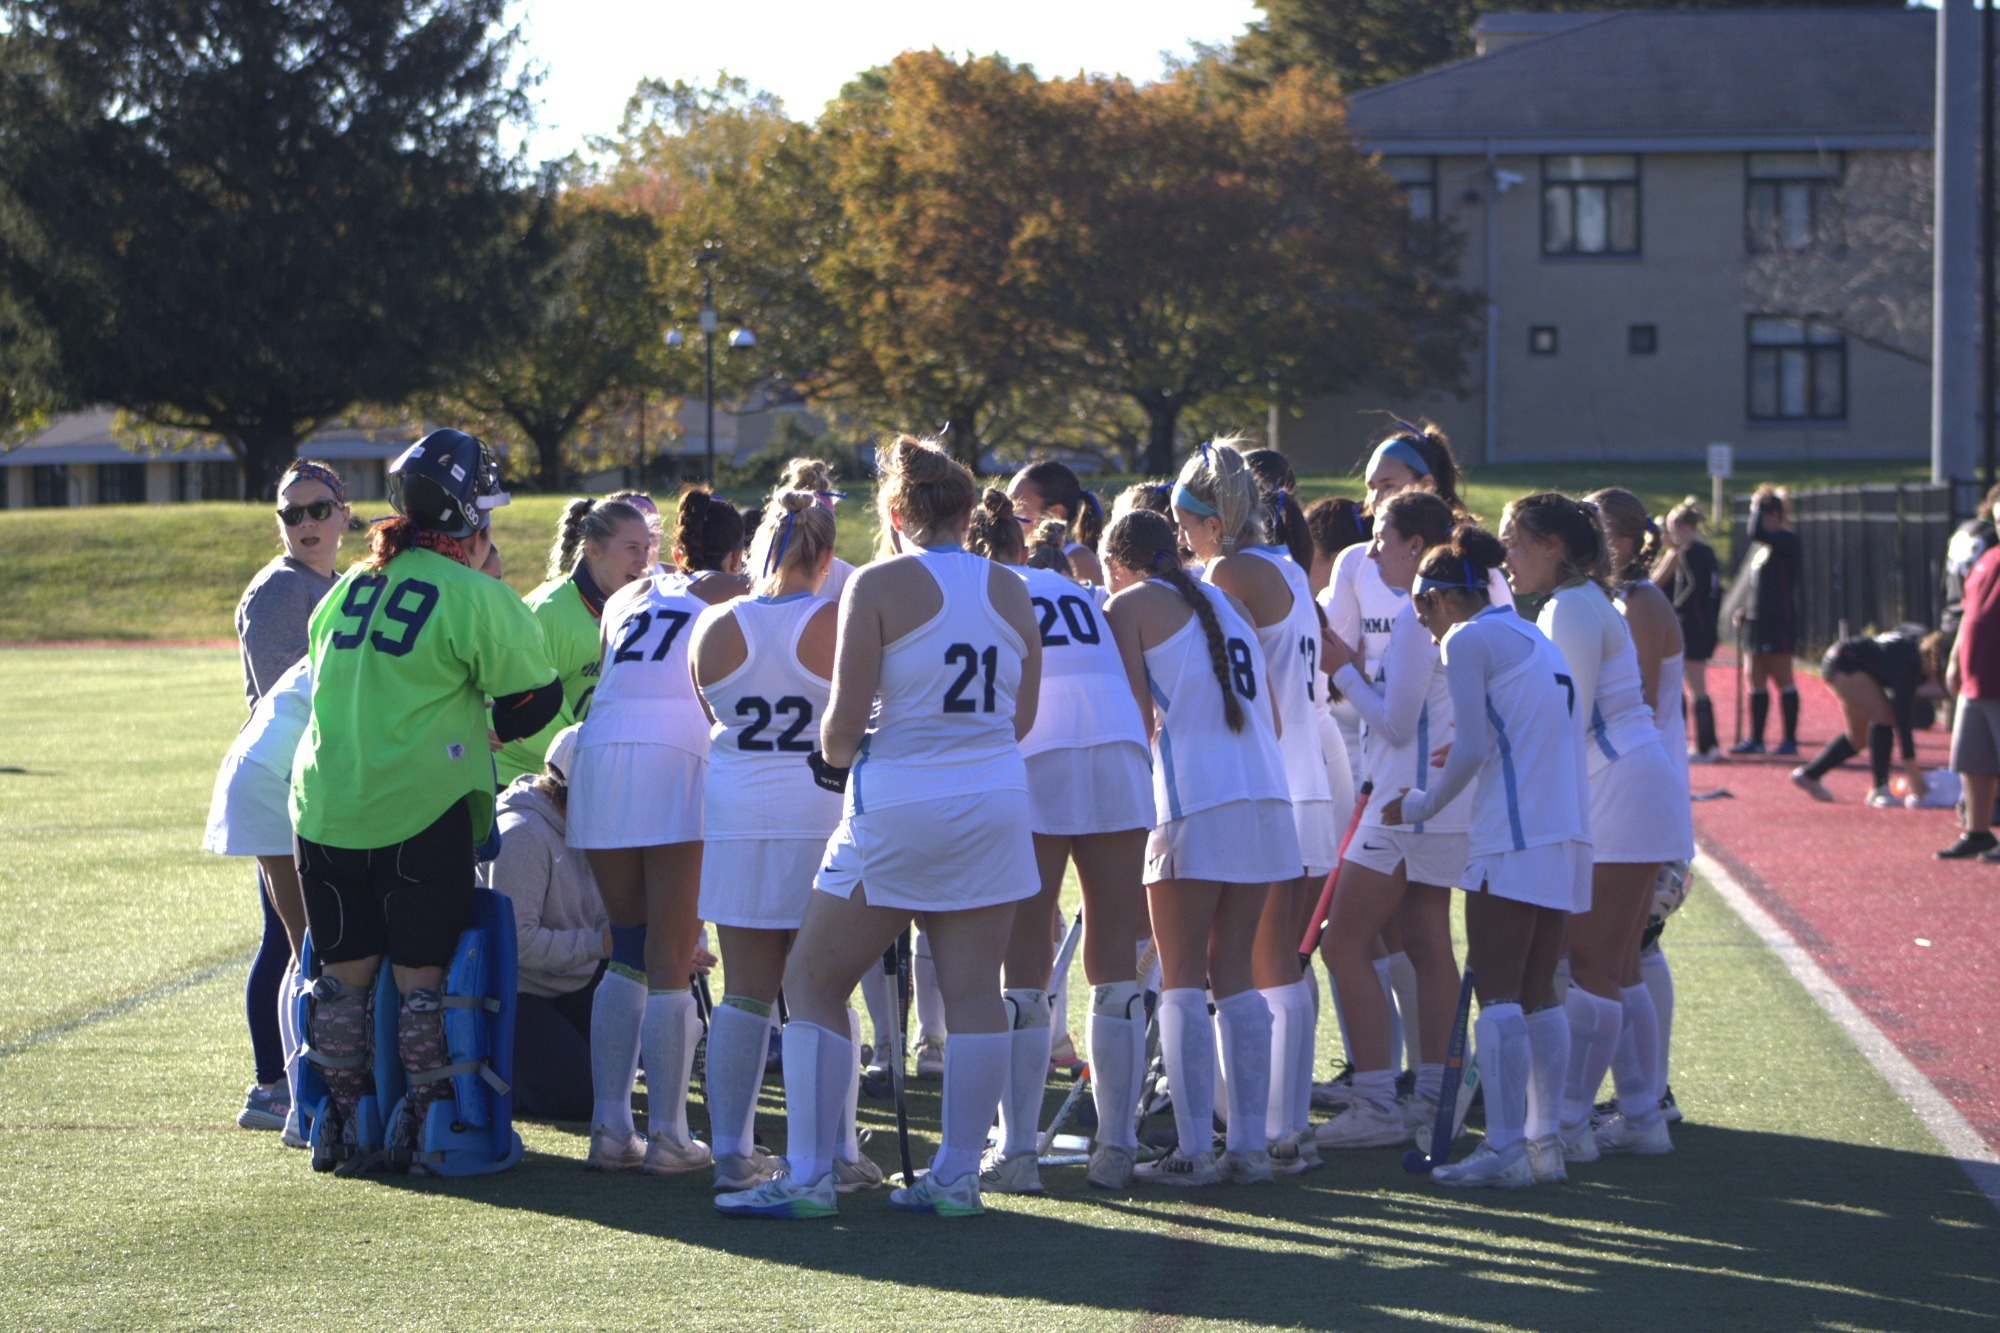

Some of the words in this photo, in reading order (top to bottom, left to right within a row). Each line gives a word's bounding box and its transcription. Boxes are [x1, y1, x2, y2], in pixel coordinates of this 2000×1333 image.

[332, 574, 440, 657] 99
[613, 609, 692, 664] 27
[1031, 595, 1100, 648] 20
[943, 643, 998, 713] 21
[1553, 673, 1575, 718] 7
[735, 696, 814, 751] 22
[821, 776, 840, 787] STX
